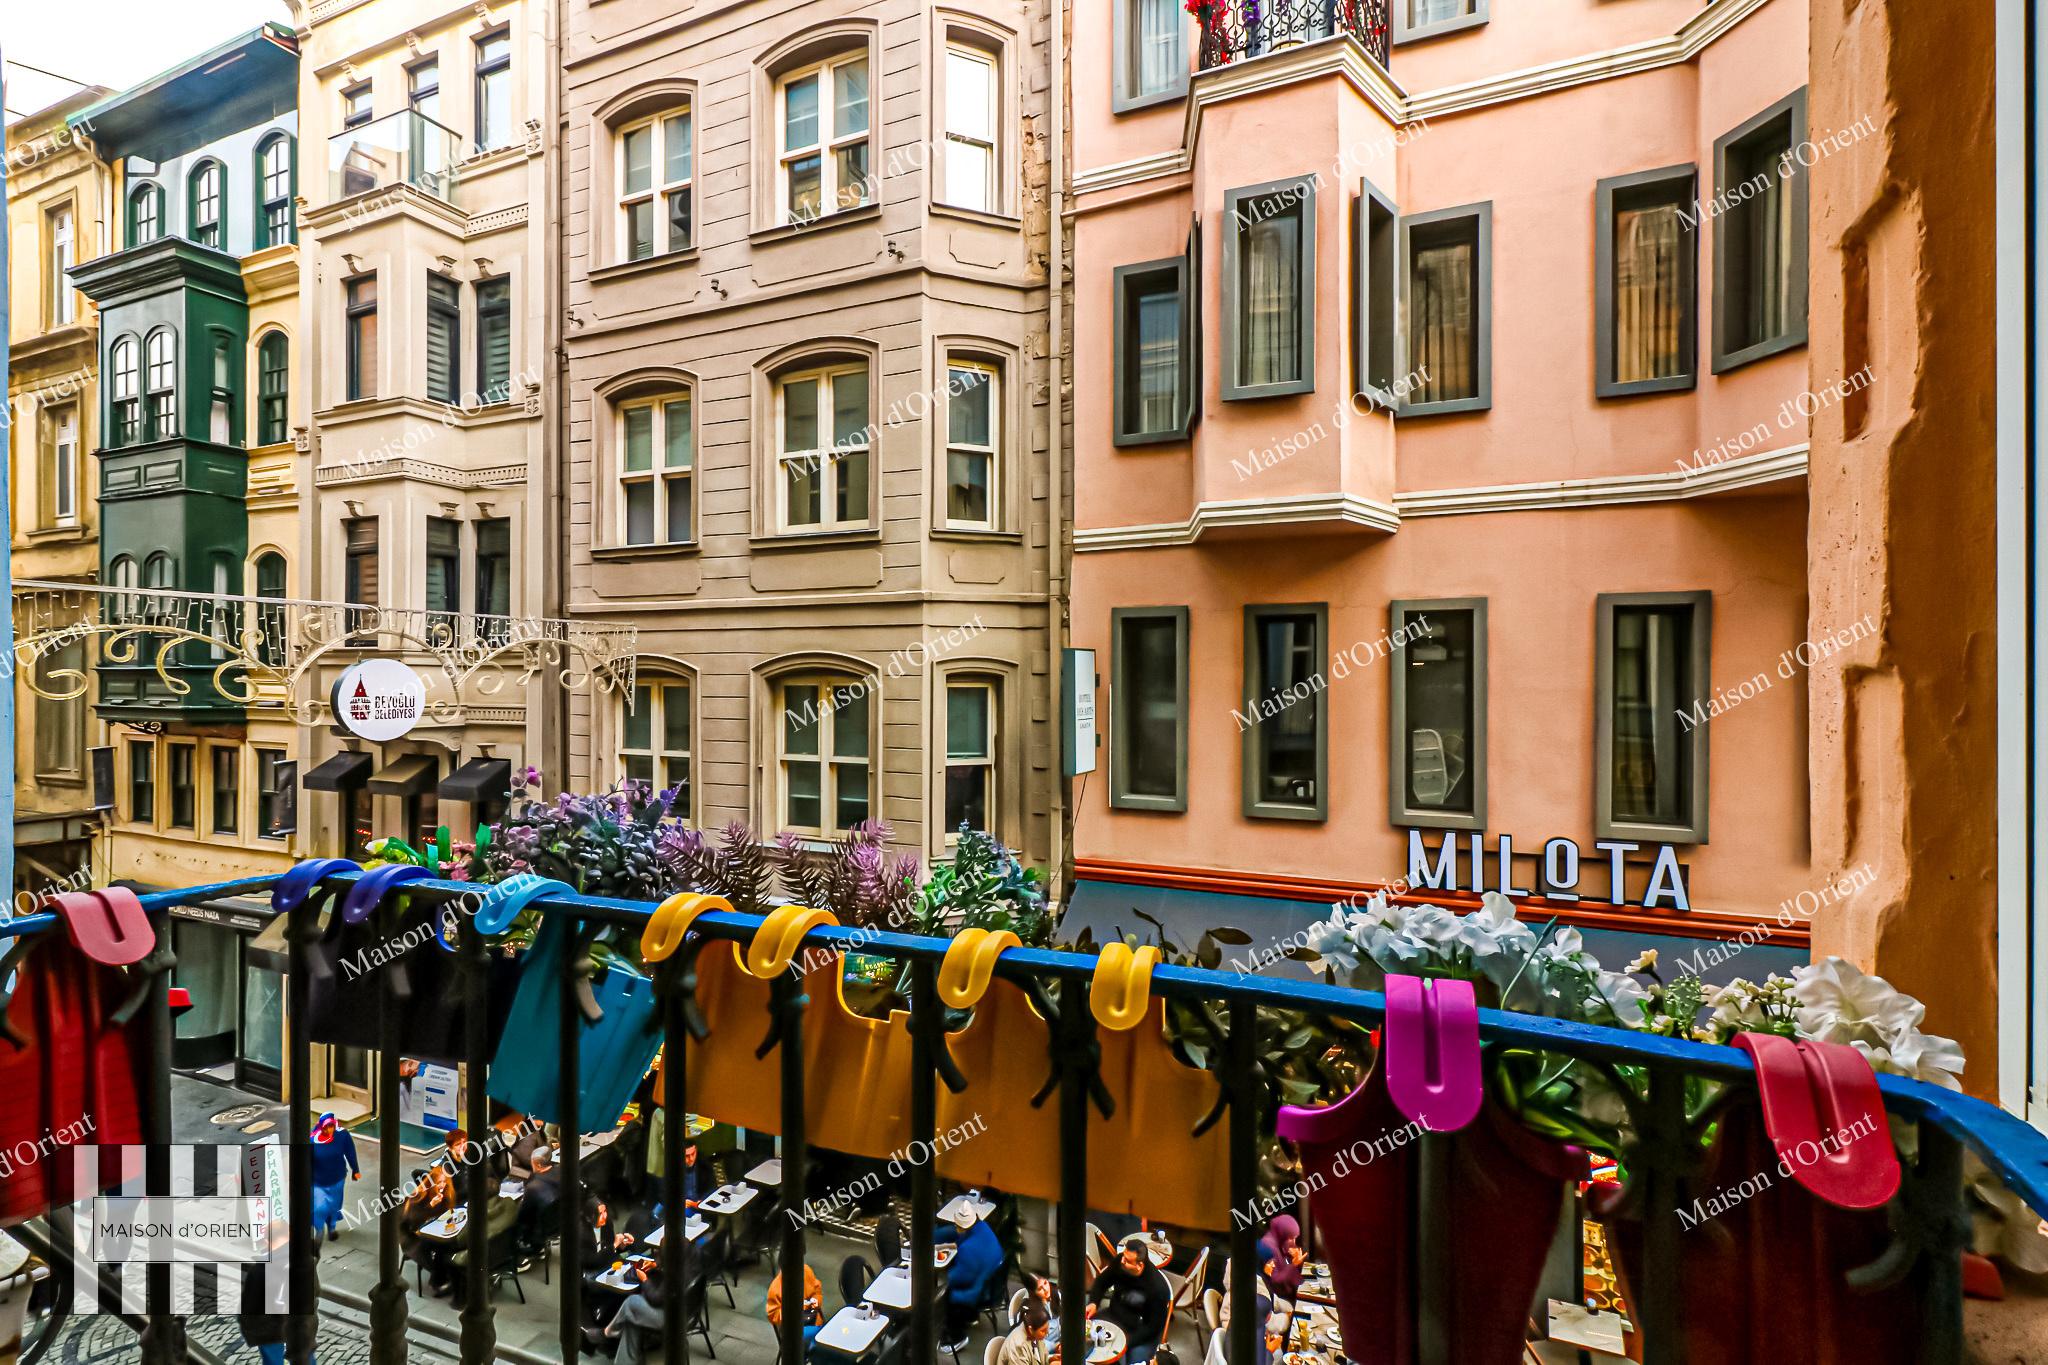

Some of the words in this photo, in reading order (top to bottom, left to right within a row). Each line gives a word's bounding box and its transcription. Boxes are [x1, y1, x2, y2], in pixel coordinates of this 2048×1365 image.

[1408, 828, 1691, 911] MILOTA
[249, 1156, 266, 1235] ECZANE
[267, 1149, 286, 1222] PHARMAC
